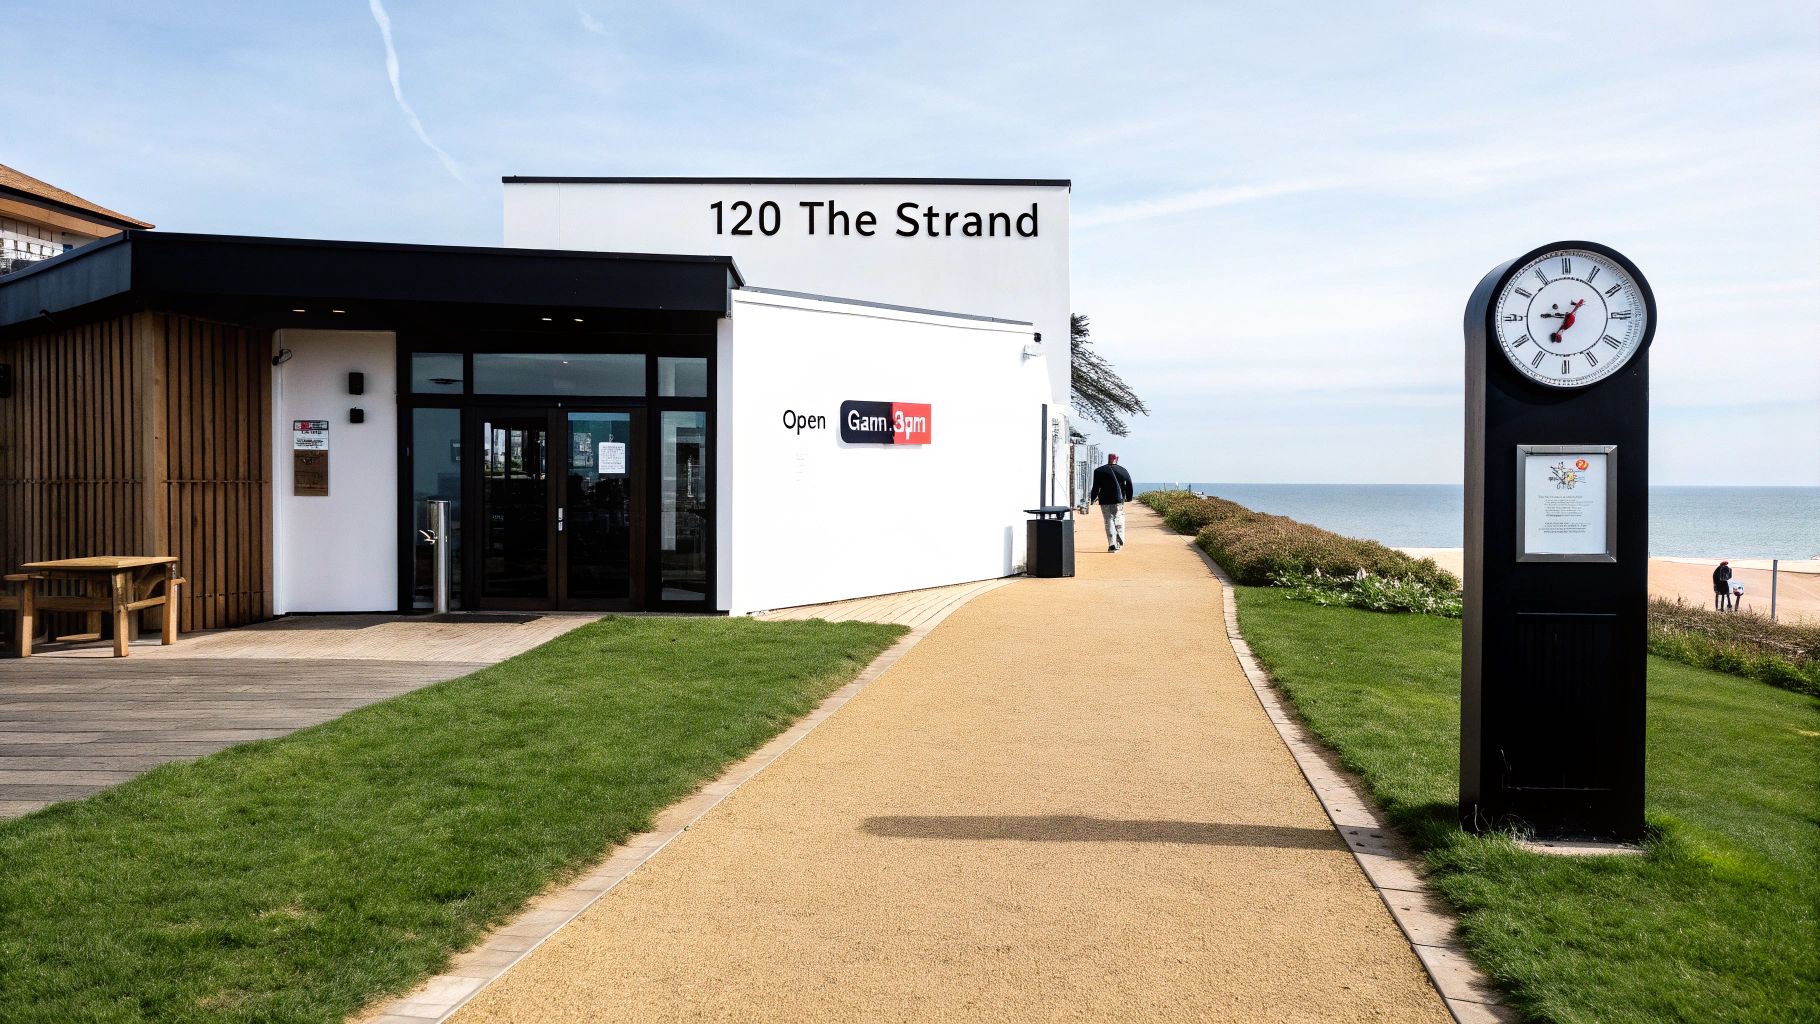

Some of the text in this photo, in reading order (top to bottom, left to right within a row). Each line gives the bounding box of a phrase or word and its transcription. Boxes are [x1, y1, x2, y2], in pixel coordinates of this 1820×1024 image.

[710, 199, 1039, 238] 120 The Strand
[782, 409, 826, 436] Open
